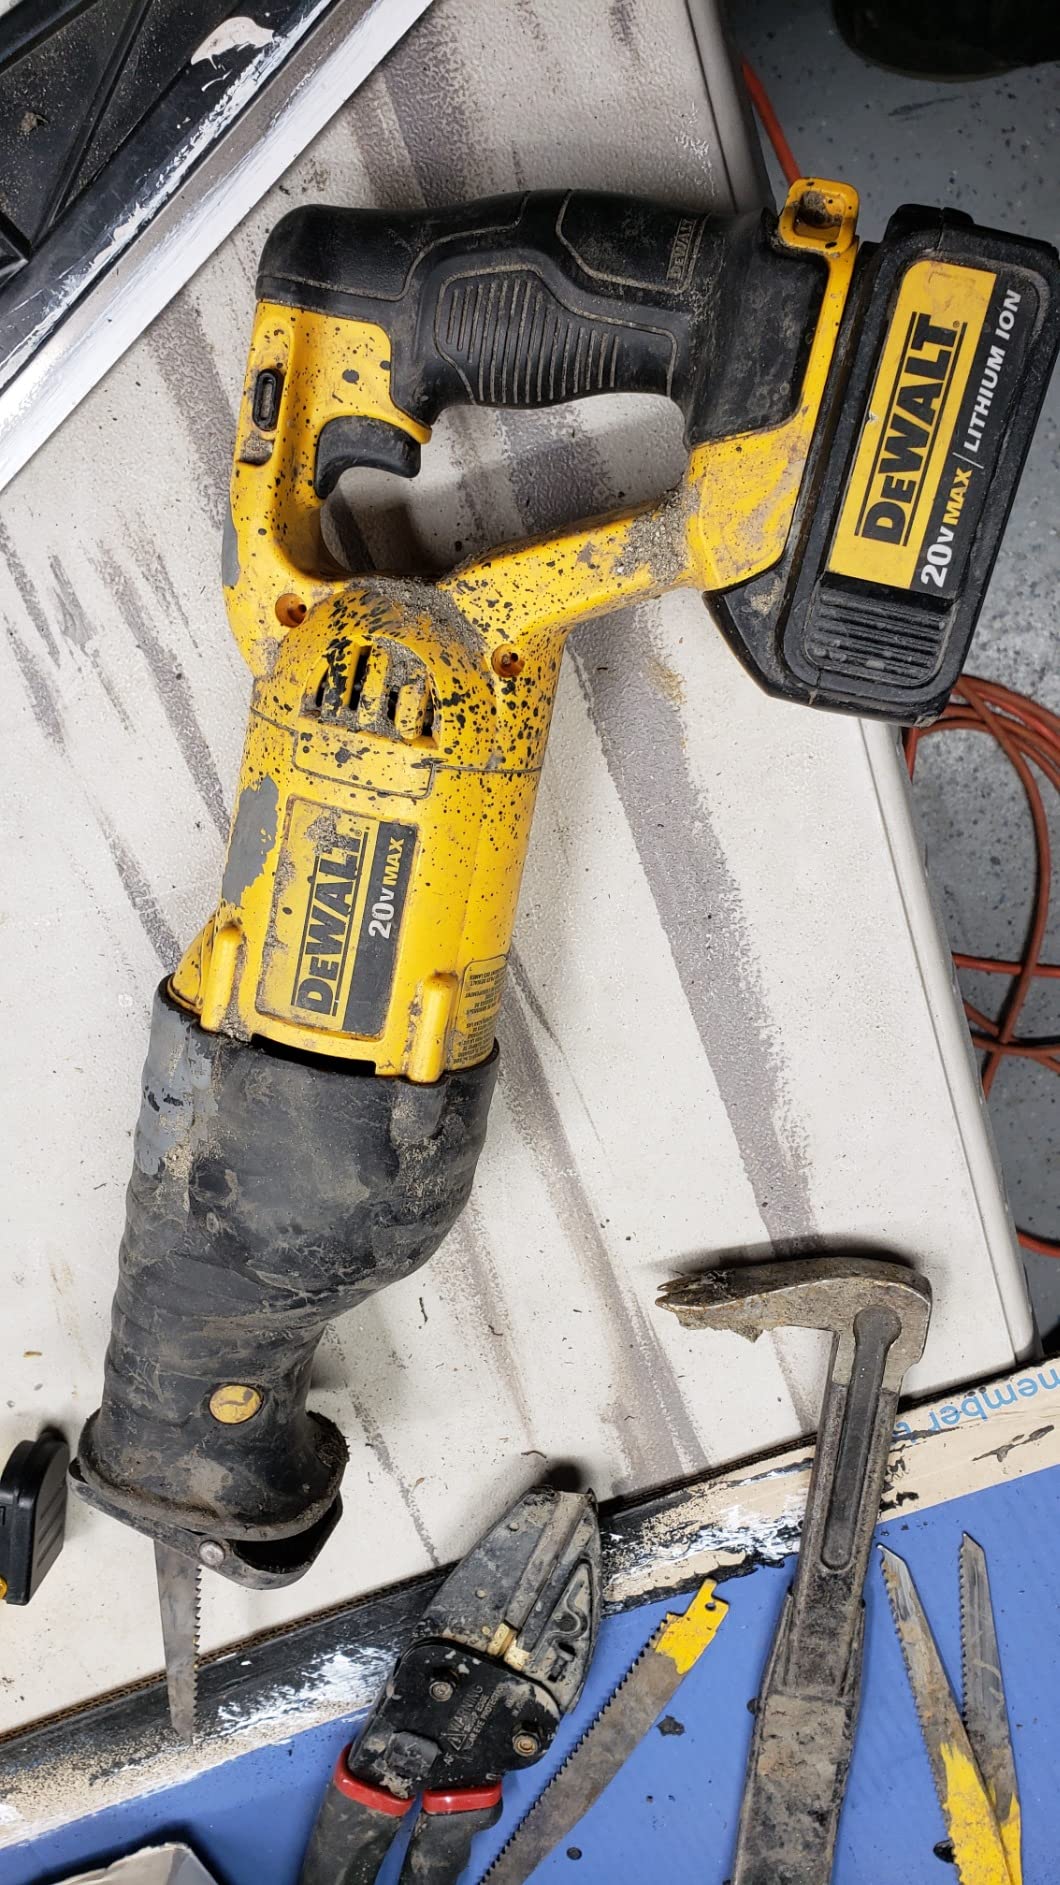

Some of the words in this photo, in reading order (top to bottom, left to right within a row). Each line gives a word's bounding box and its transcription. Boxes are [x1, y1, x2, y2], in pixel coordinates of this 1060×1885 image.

[668, 219, 694, 279] DEWALT
[861, 312, 958, 545] DEWALT
[942, 467, 973, 526] MAX
[964, 345, 1006, 453] LITHIUM
[995, 289, 1022, 341] ION
[294, 827, 361, 1015] DEWALT
[382, 837, 405, 886] MAX
[447, 1684, 483, 1734] WARNING
